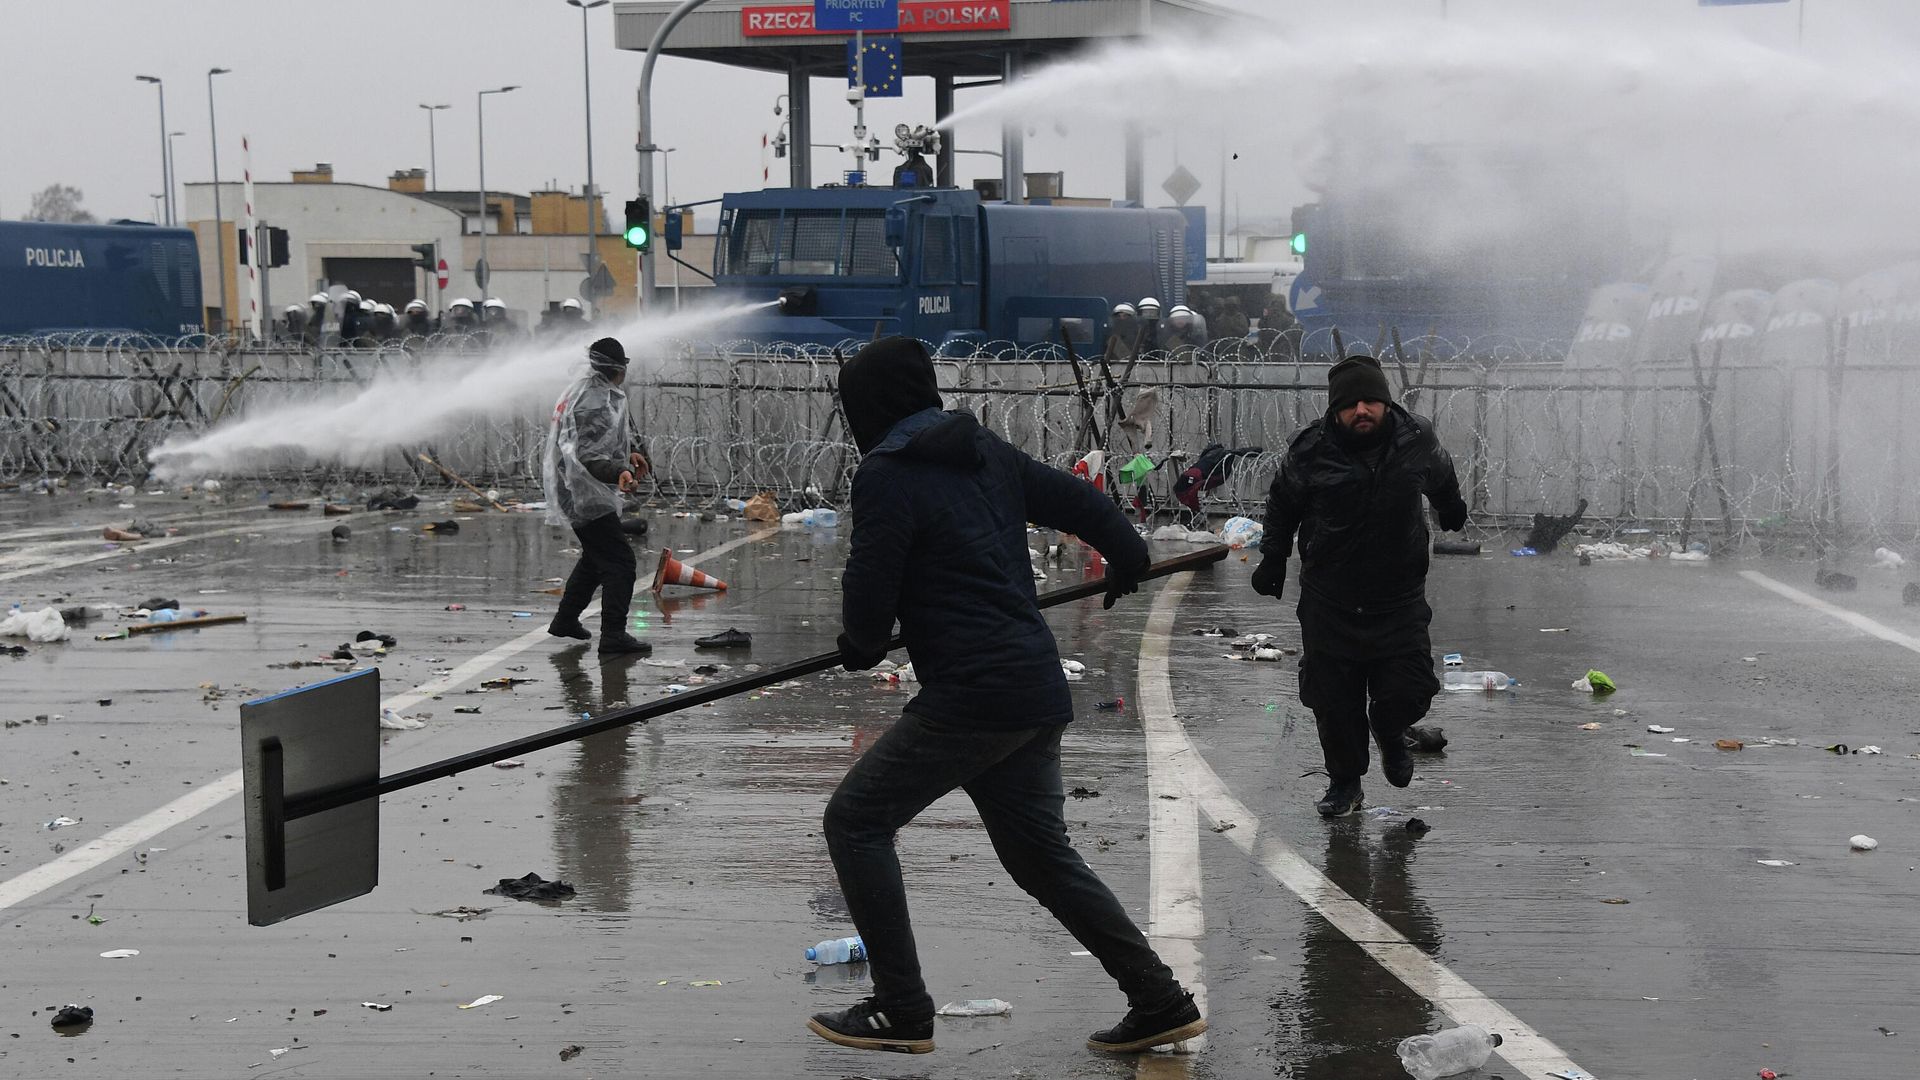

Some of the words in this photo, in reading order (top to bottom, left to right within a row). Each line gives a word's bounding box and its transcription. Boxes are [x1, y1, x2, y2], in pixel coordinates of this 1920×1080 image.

[825, 0, 886, 9] PRIORYTETY
[849, 12, 864, 22] PC
[922, 6, 1001, 25] POLSKA
[25, 248, 85, 268] POLICJA
[919, 296, 951, 315] POLICJA
[1648, 298, 1700, 320] MP
[1700, 323, 1754, 342] MP
